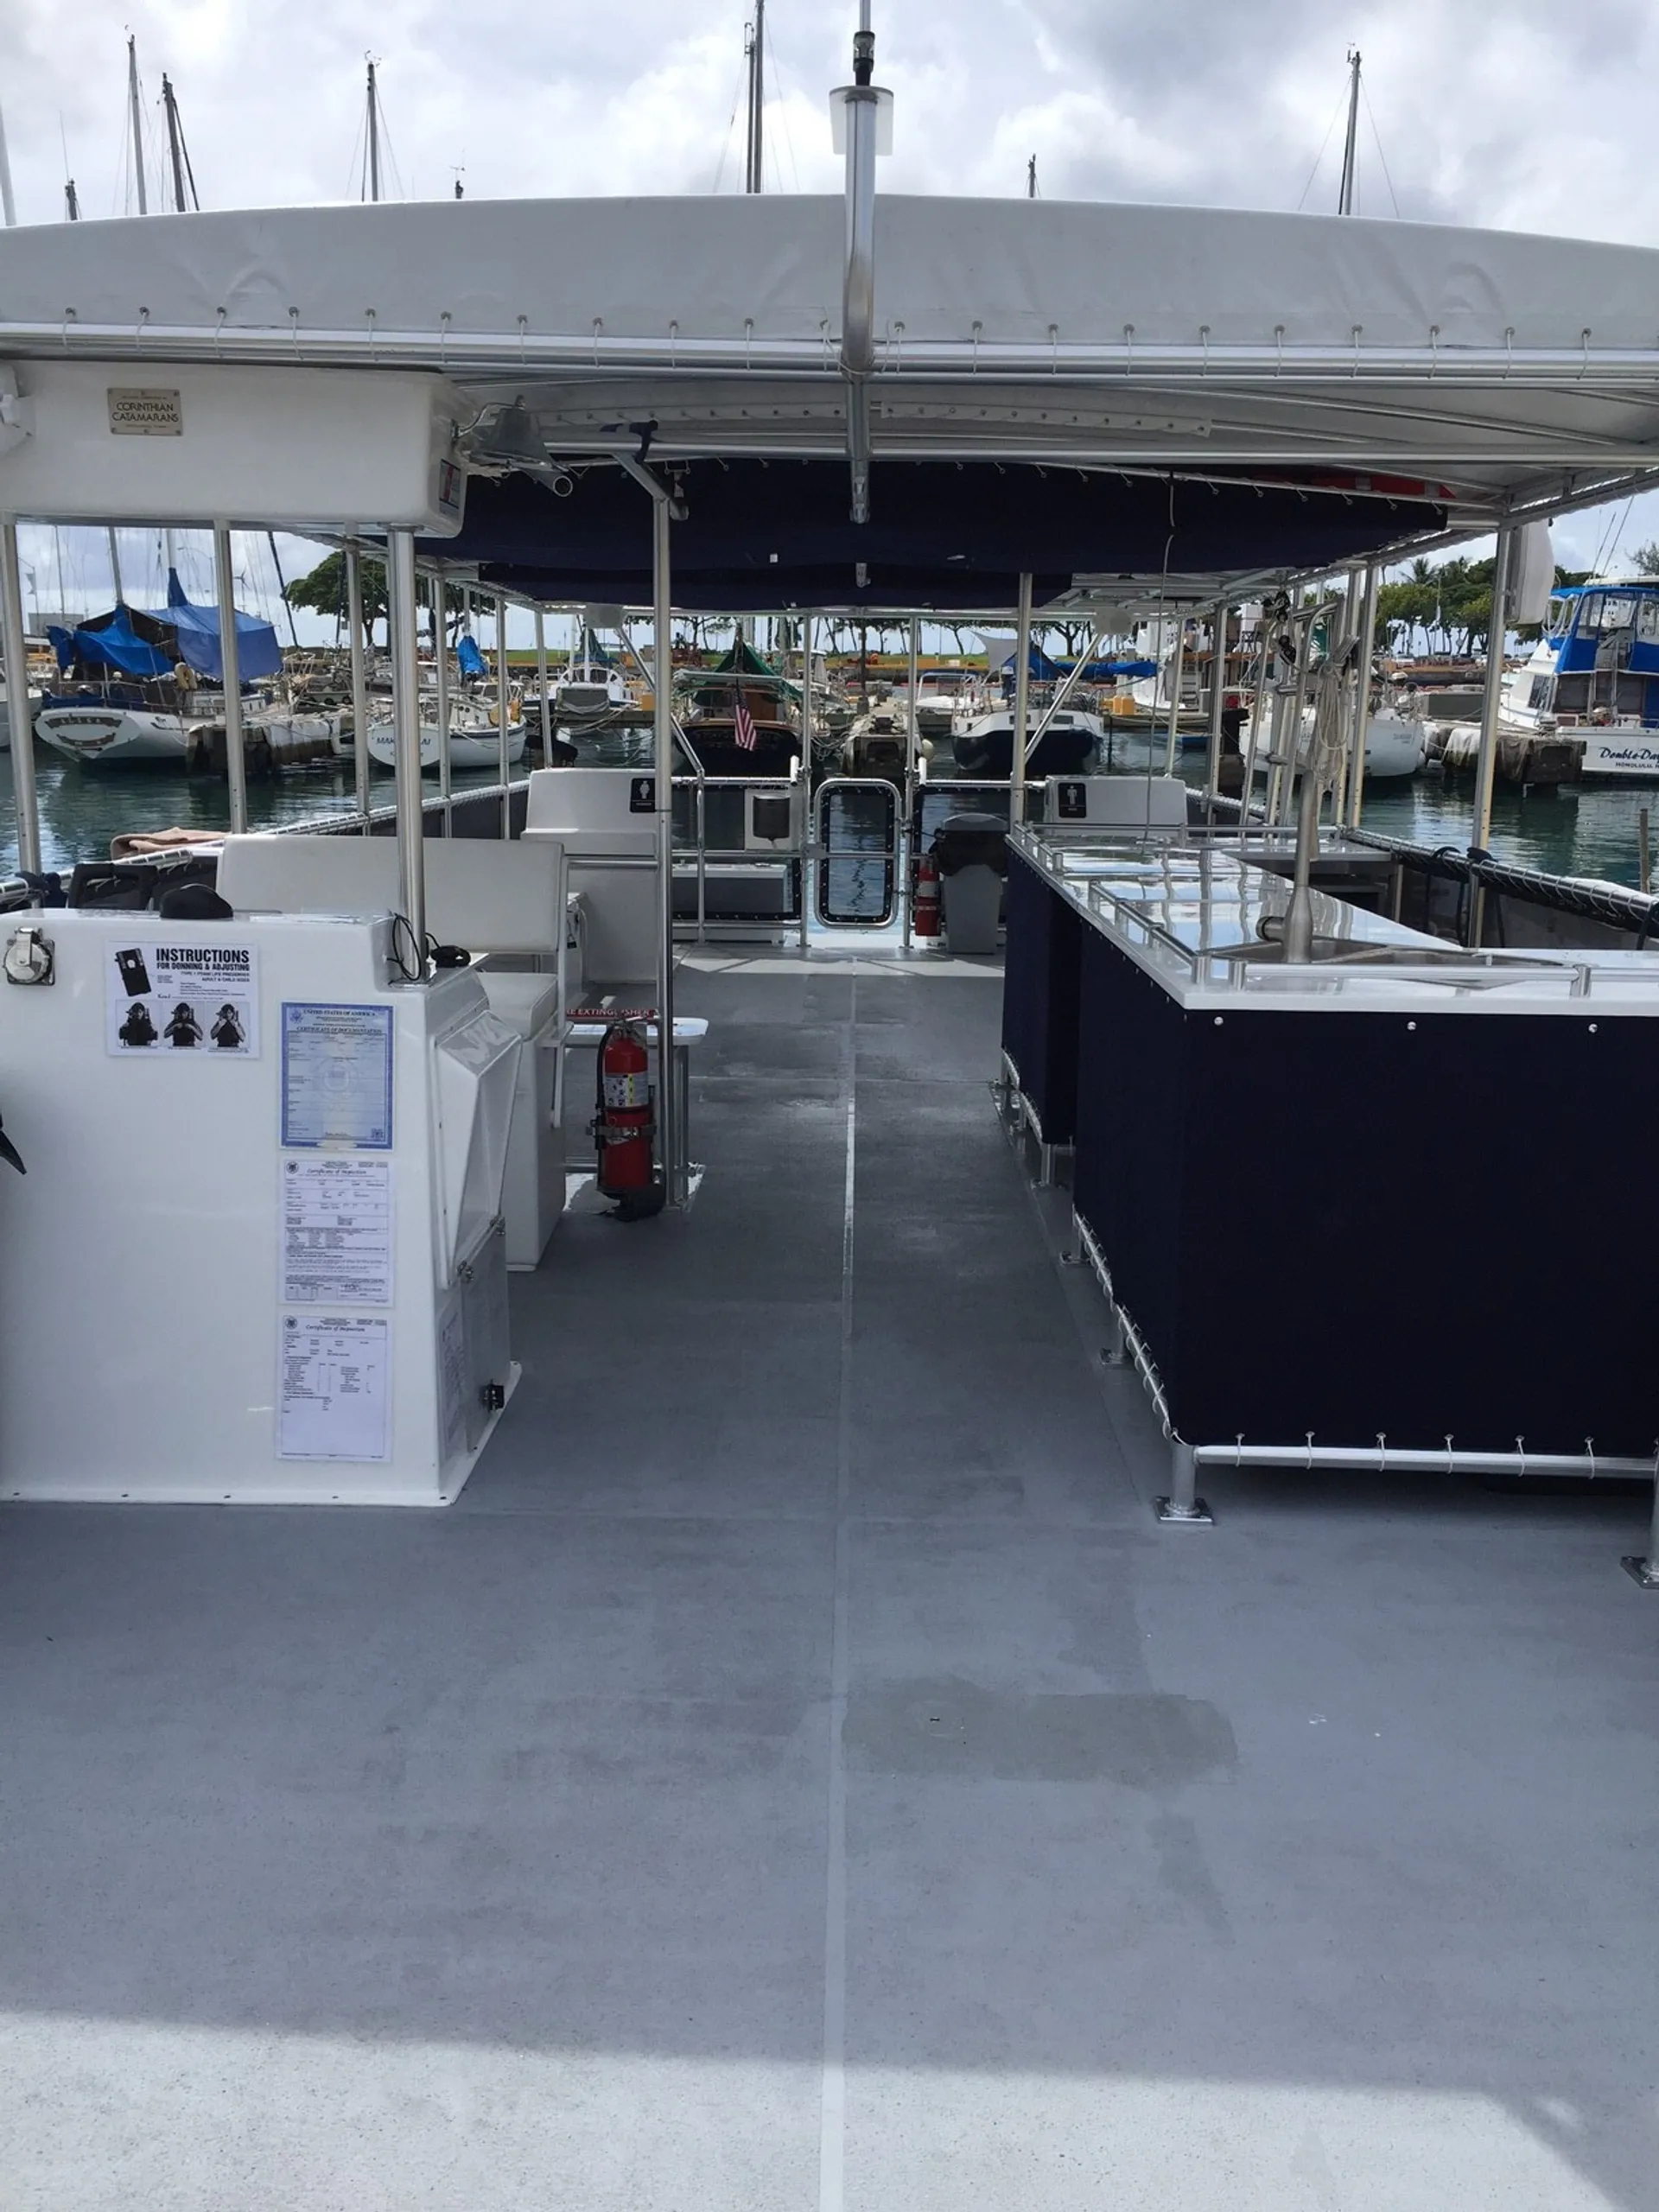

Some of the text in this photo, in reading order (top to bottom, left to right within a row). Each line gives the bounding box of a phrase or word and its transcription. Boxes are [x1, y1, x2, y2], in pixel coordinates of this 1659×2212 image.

[116, 402, 174, 411] CORINTHIAN
[111, 412, 179, 422] CATAMARANS
[156, 948, 250, 963] INSTRUCTIONS
